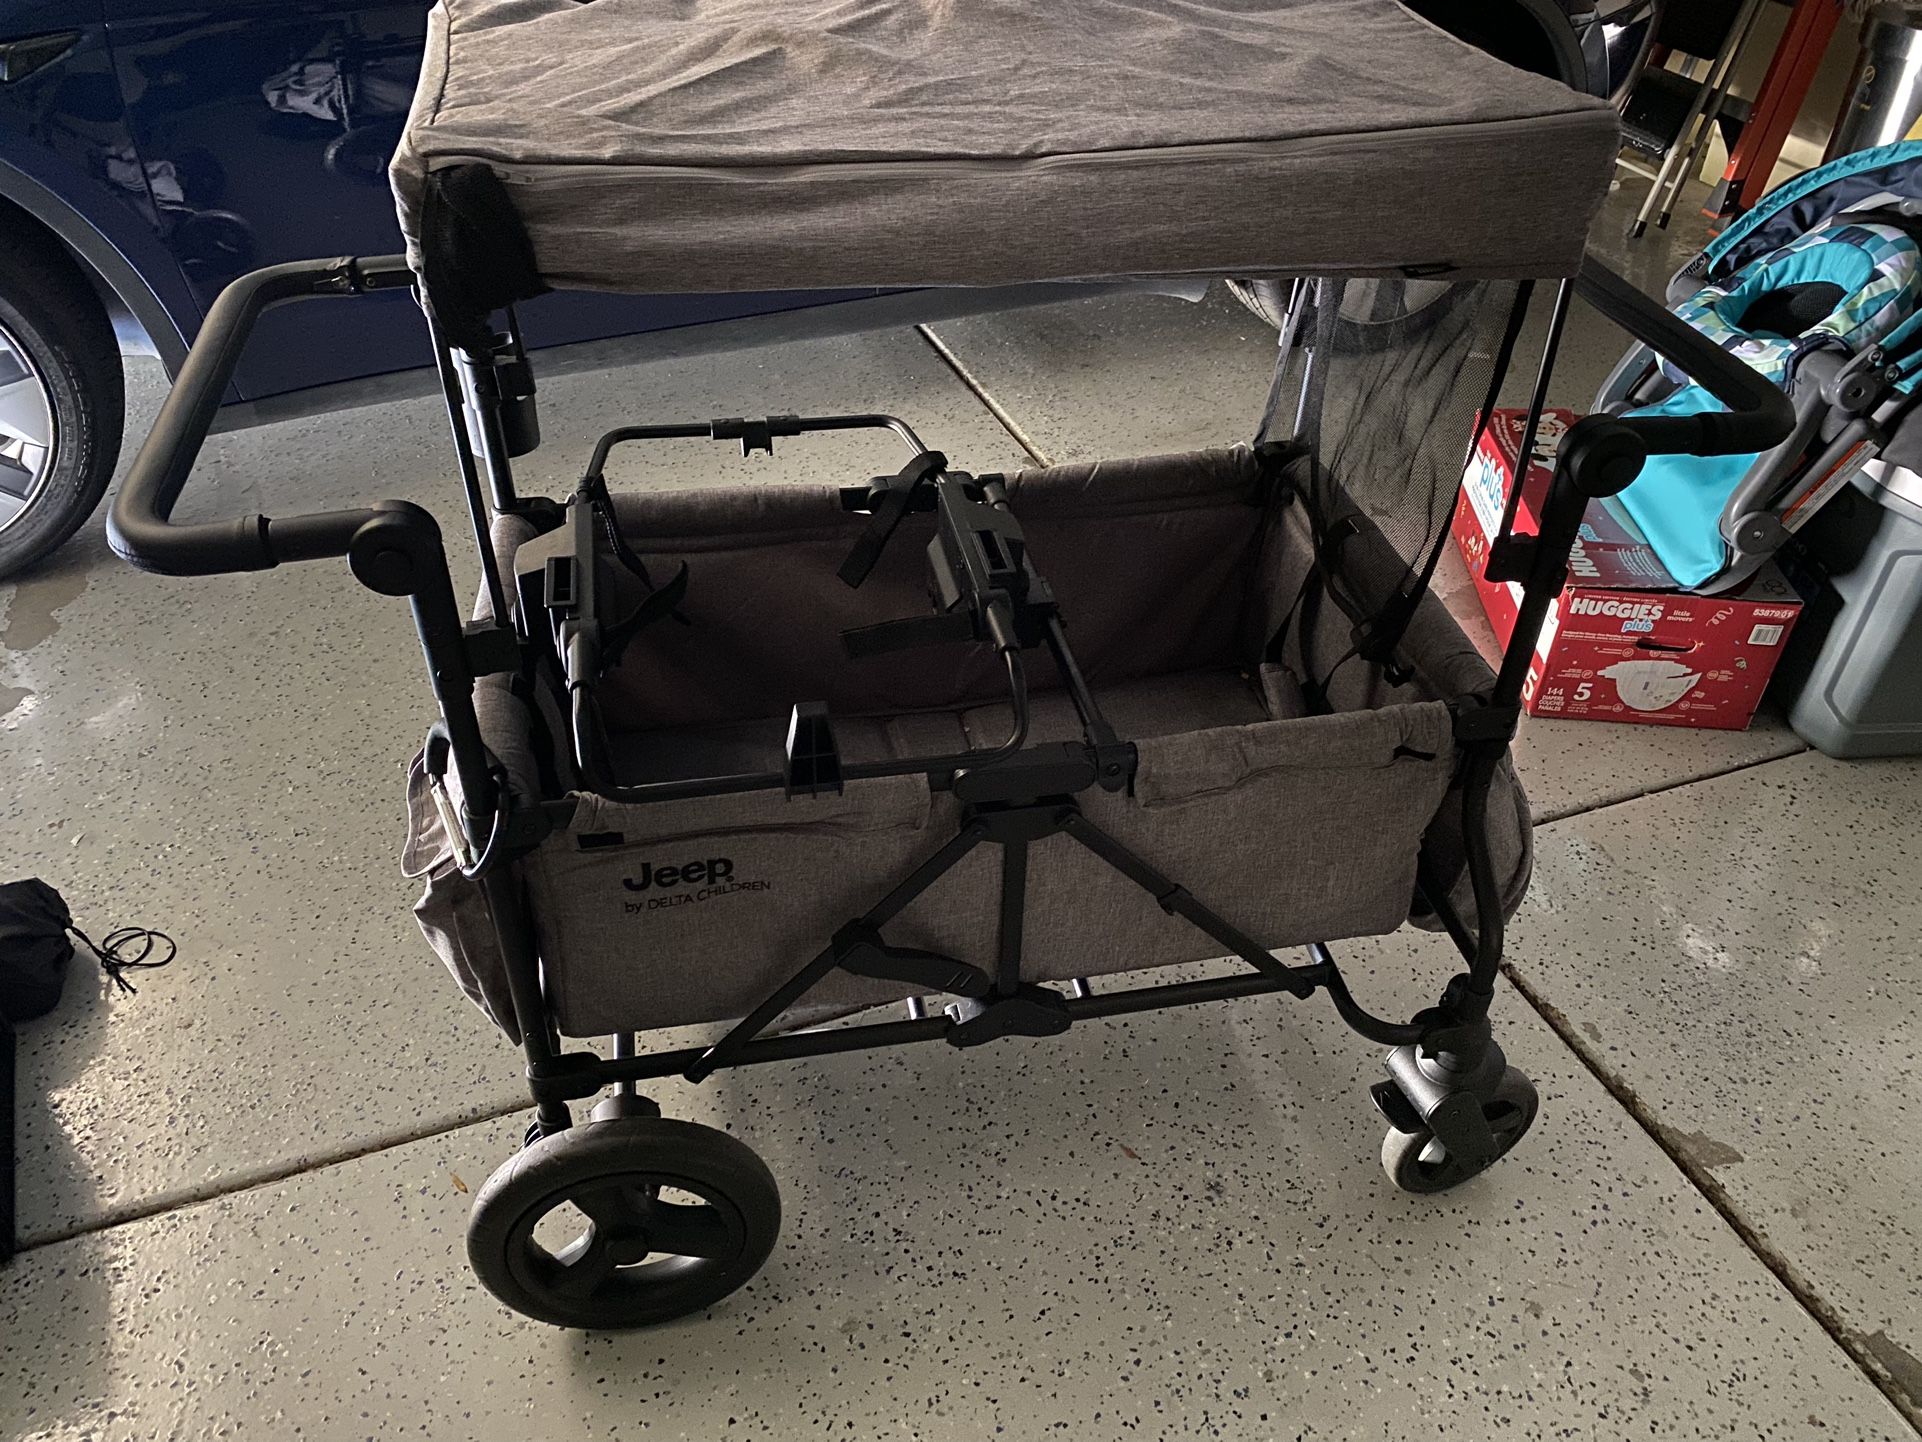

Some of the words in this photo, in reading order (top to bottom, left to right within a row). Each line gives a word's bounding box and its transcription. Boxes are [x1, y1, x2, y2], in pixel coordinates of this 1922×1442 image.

[1480, 462, 1502, 511] plus
[1569, 597, 1664, 620] HUGGIES
[1667, 614, 1694, 622] movers
[1621, 618, 1654, 632] plus
[1547, 686, 1564, 696] 144
[1572, 682, 1593, 701] 5
[623, 858, 733, 892] Jeep
[625, 901, 642, 914] by
[648, 894, 694, 910] DELTA
[696, 880, 770, 901] CHILDREN
